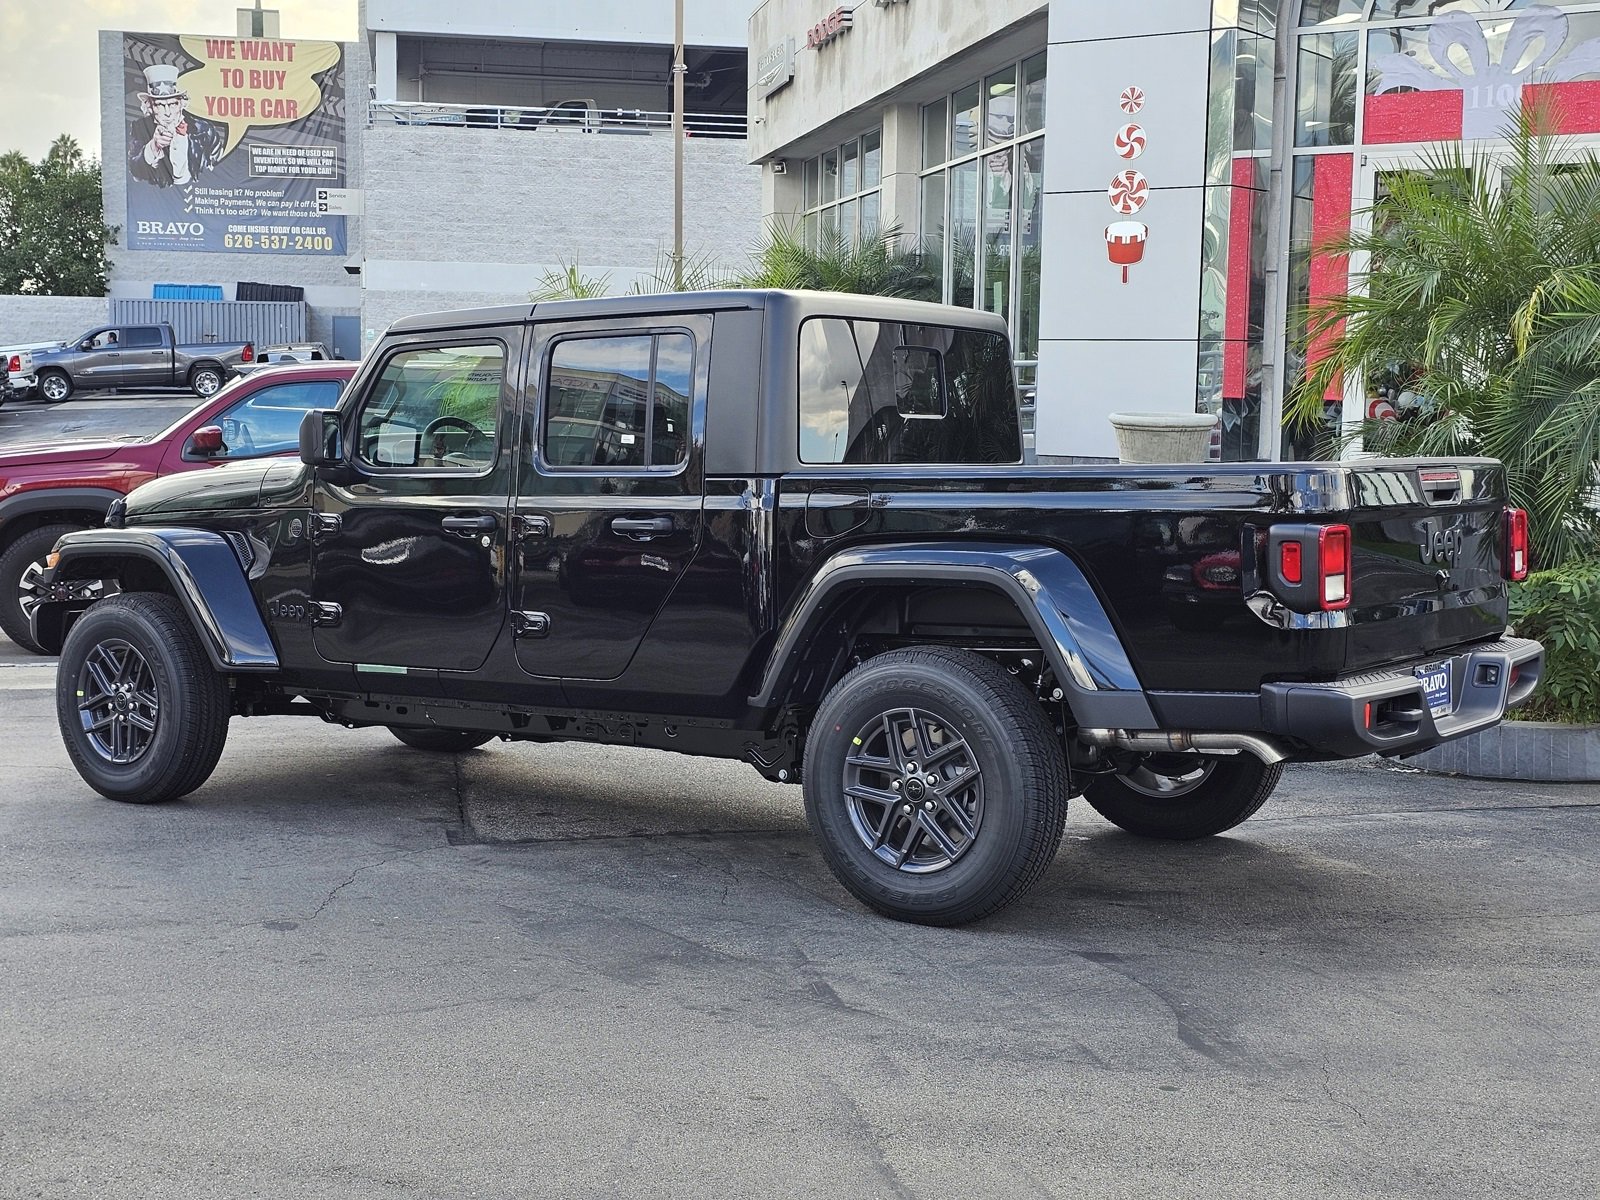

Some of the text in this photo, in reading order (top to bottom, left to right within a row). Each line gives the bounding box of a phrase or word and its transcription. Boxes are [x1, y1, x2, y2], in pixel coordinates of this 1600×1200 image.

[807, 6, 852, 50] DODGE
[206, 39, 296, 62] WE WANT
[220, 68, 286, 90] TO BUY
[205, 96, 298, 119] YOUR CAR
[317, 167, 332, 175] CAR!
[194, 197, 218, 206] Making
[220, 198, 254, 207] Payments,
[209, 188, 232, 197] leasing
[234, 188, 243, 196] it?
[239, 208, 258, 216] old??
[137, 221, 204, 235] BRAVO
[248, 225, 269, 233] INSIDE
[270, 226, 290, 234] TODAY
[224, 234, 333, 250] 626-537-2400
[1419, 521, 1463, 569] Jeep
[270, 599, 305, 622] Jeep
[844, 679, 997, 753] BRIDGESTONE
